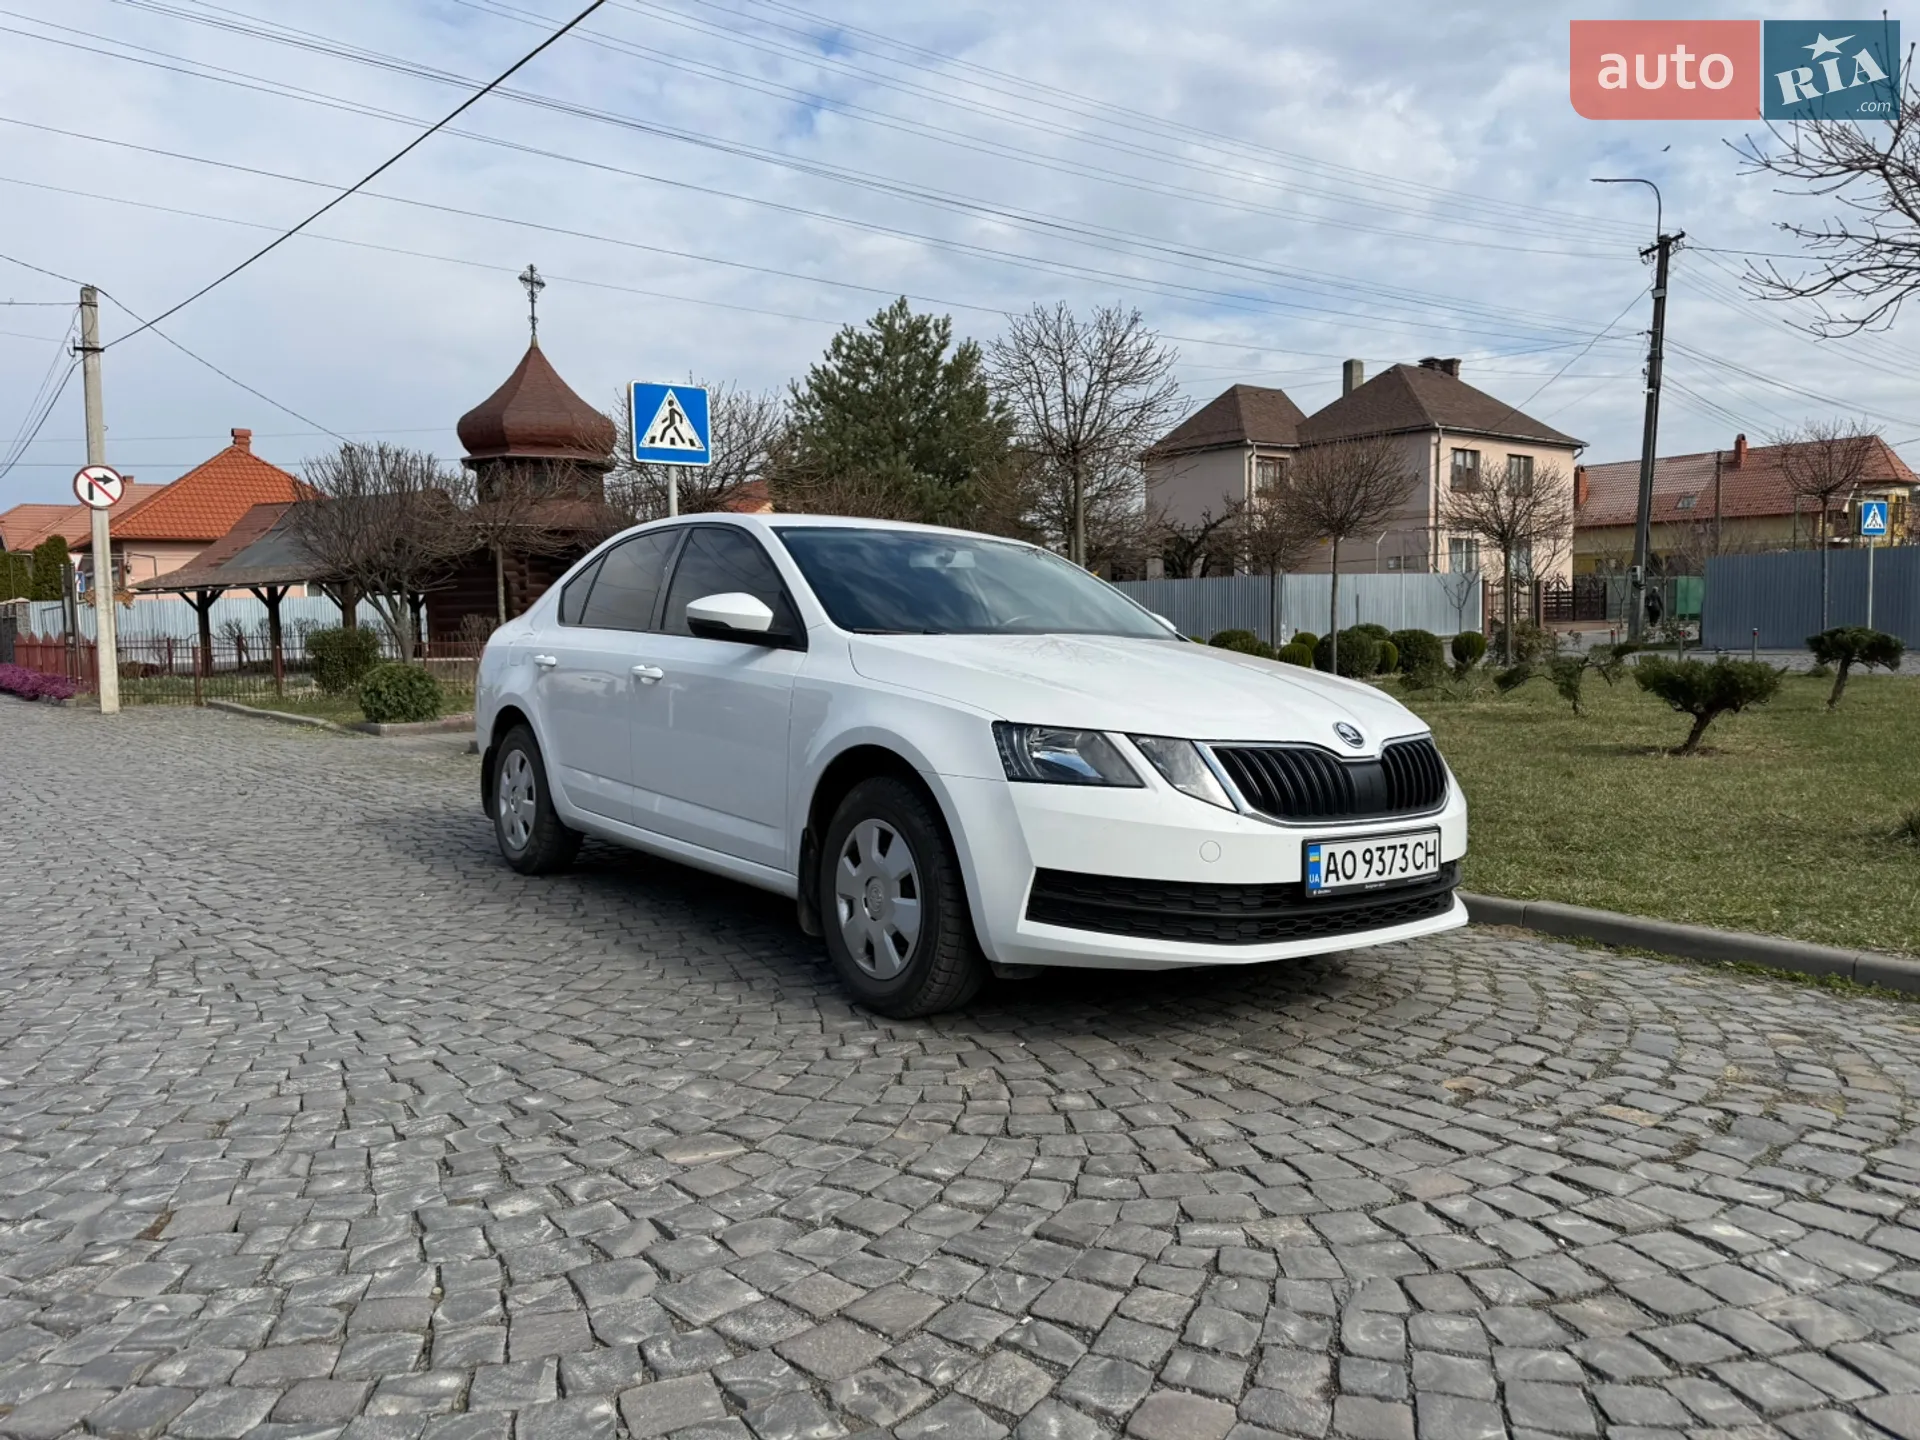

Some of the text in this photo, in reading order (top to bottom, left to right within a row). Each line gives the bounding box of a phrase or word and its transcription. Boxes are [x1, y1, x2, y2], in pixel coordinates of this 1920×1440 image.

[1324, 839, 1437, 883] AO 9373 CH
[1309, 874, 1320, 883] UA
